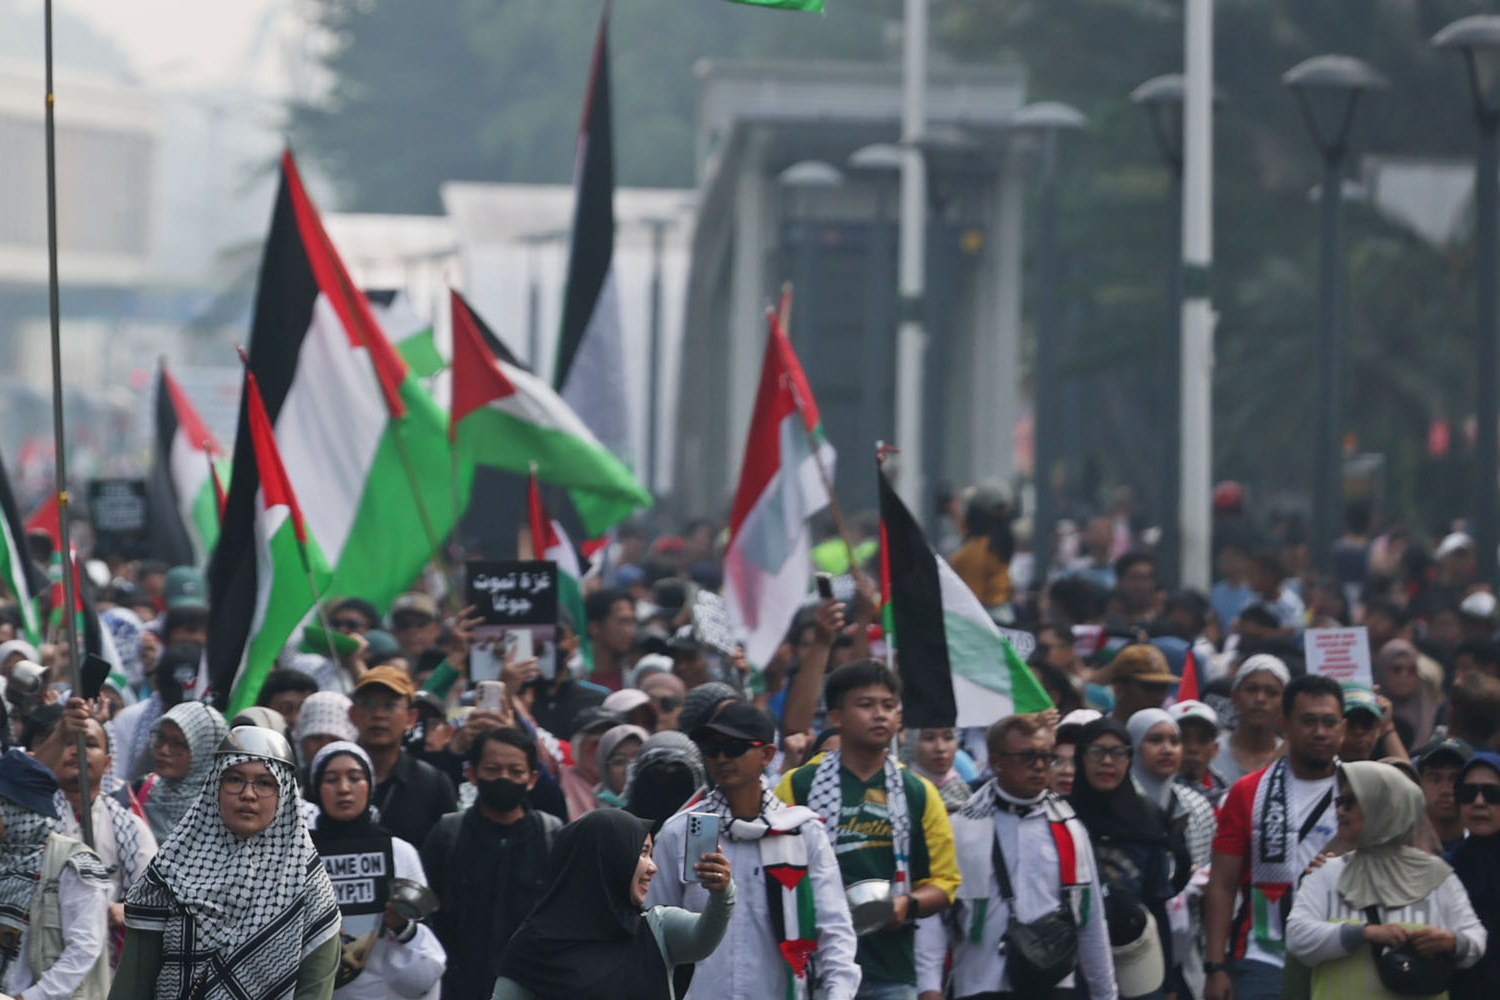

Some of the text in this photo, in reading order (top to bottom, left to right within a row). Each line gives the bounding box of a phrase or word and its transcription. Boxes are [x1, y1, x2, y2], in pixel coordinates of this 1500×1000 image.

[325, 856, 381, 876] AME ON
[335, 882, 372, 901] YPT!
